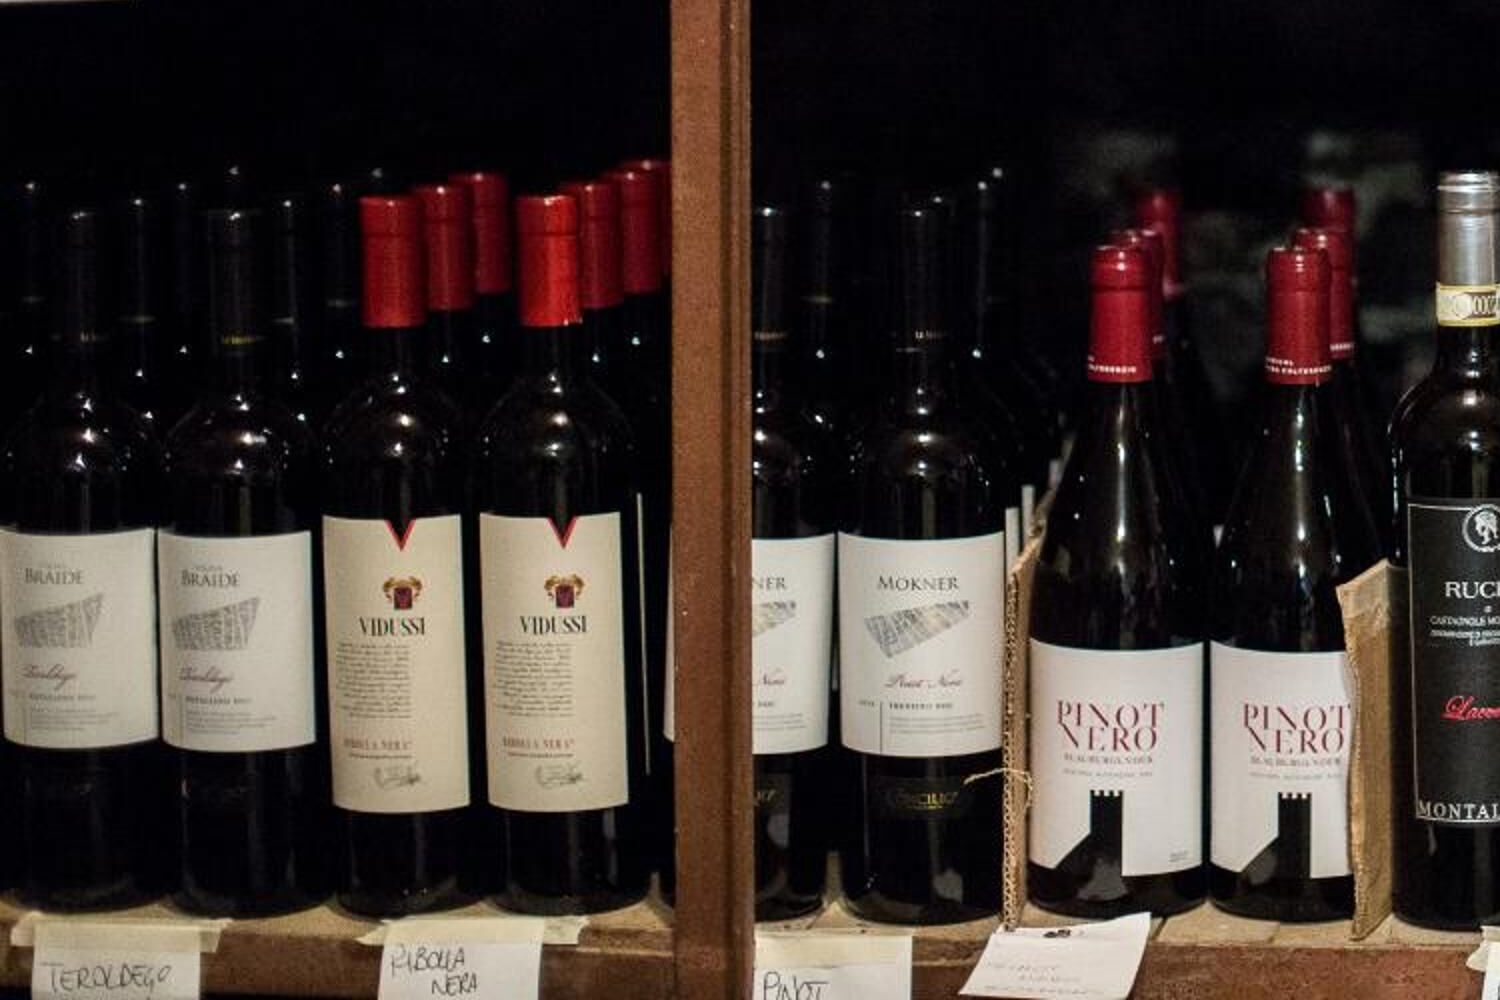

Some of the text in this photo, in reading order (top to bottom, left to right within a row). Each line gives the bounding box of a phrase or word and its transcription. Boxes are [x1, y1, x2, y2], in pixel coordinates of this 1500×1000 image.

[24, 567, 84, 586] BRAIDE
[180, 569, 241, 588] BRAIDE
[876, 576, 961, 592] MOKNER
[357, 615, 427, 637] VIDUSSI
[519, 614, 589, 636] VIDUSSI
[1057, 700, 1165, 728] PINOT
[1243, 703, 1352, 731] PINOT
[1060, 726, 1157, 752] NERO
[1247, 727, 1346, 755] NERO
[40, 962, 173, 994] TEROLDEGO
[431, 972, 478, 997] NERA
